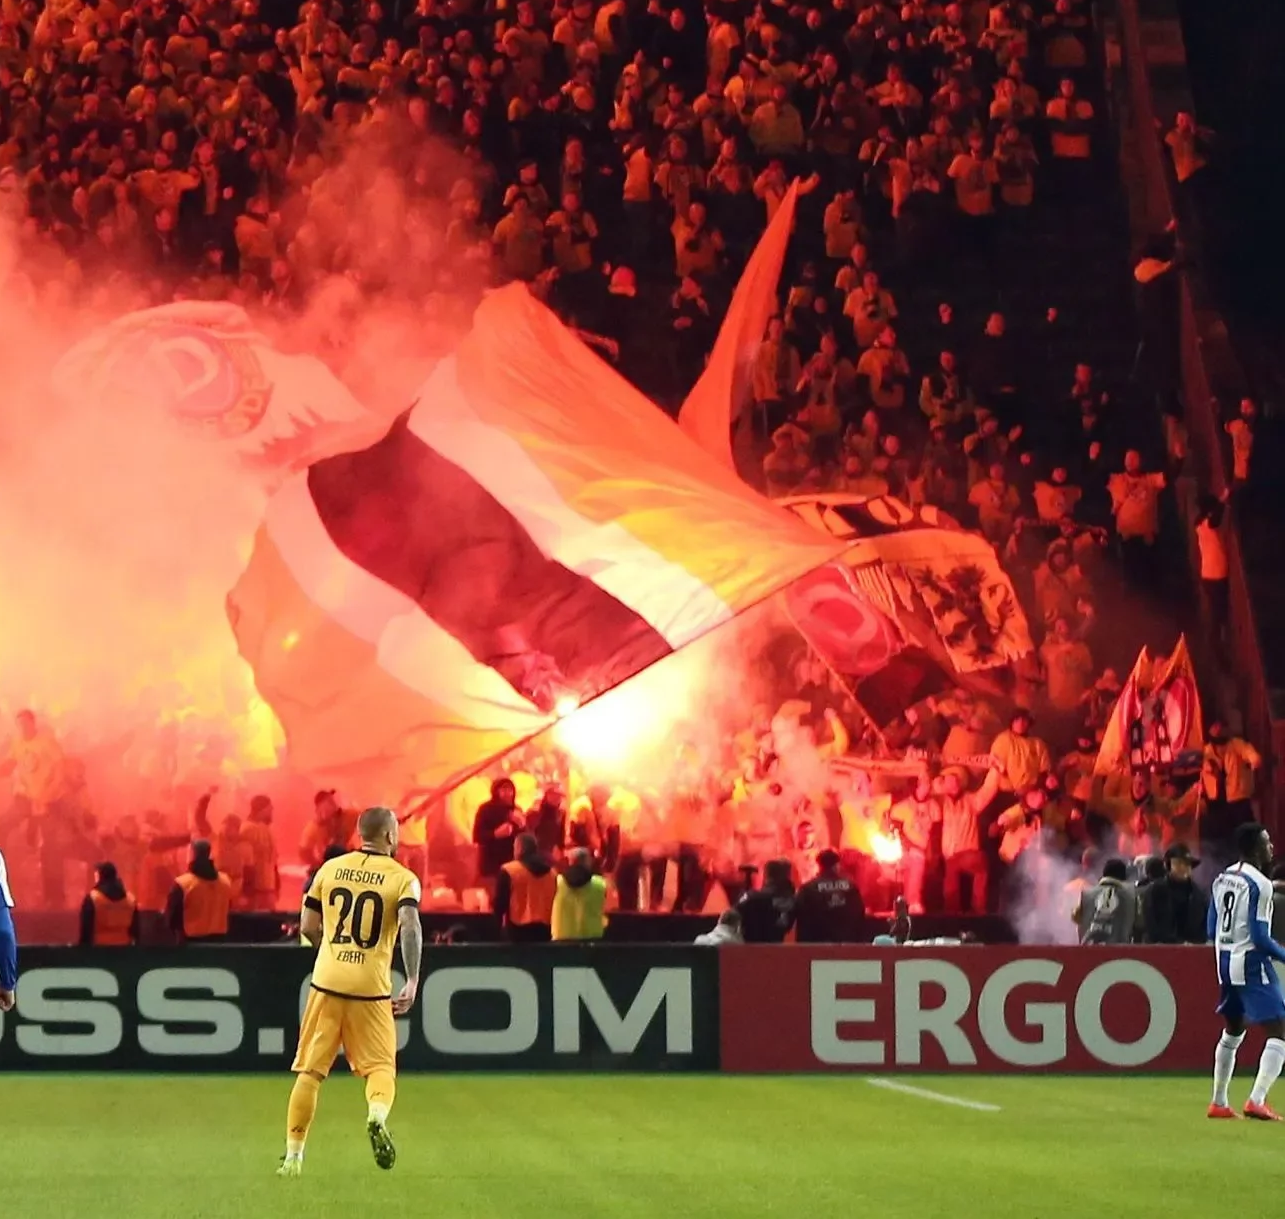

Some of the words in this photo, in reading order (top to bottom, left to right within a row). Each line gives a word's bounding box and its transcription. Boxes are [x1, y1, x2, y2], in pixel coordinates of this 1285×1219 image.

[335, 868, 385, 885] DRESDEN
[329, 887, 384, 949] 20
[1222, 891, 1235, 932] 8
[810, 959, 1177, 1067] ERGO
